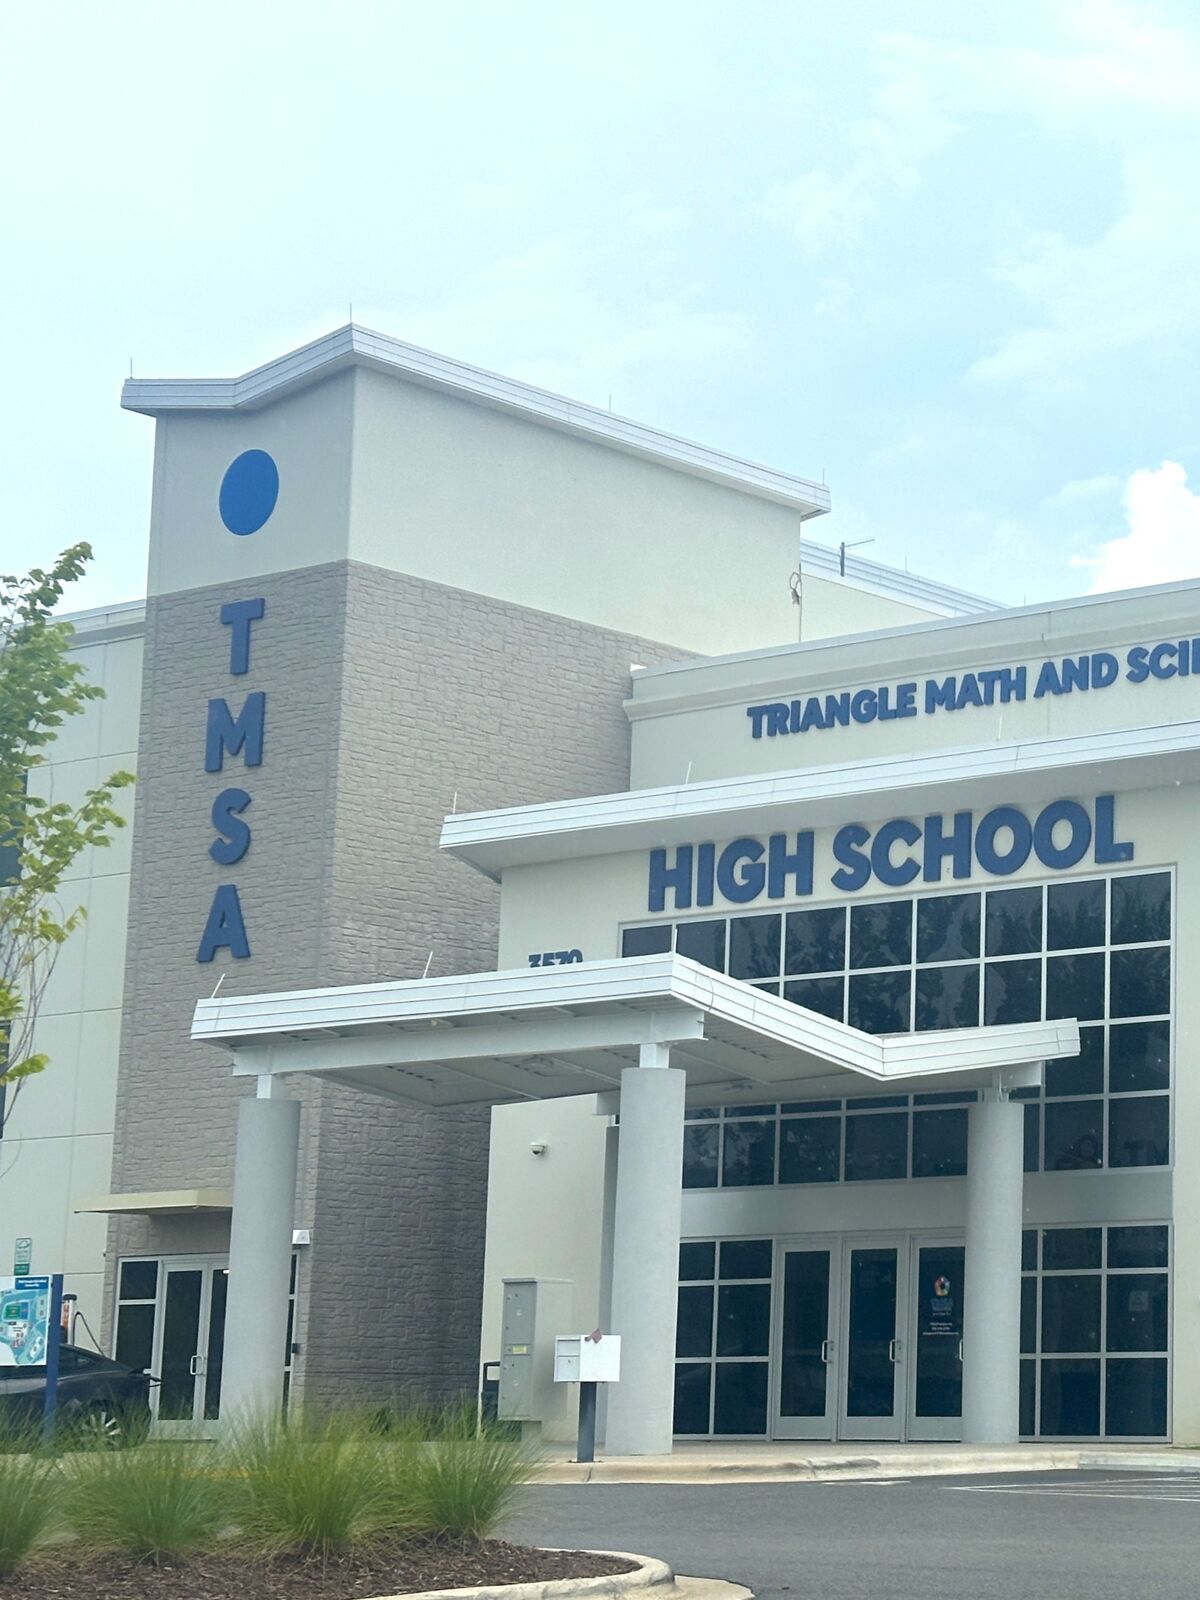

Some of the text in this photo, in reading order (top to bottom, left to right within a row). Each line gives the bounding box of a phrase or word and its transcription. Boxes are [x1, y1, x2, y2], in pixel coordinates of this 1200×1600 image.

[747, 682, 918, 739] TRIANGLE
[925, 665, 1027, 714] MATH
[1034, 652, 1119, 698] AND
[196, 598, 266, 963] TMSA
[648, 795, 1135, 912] HIGH SCHOOL
